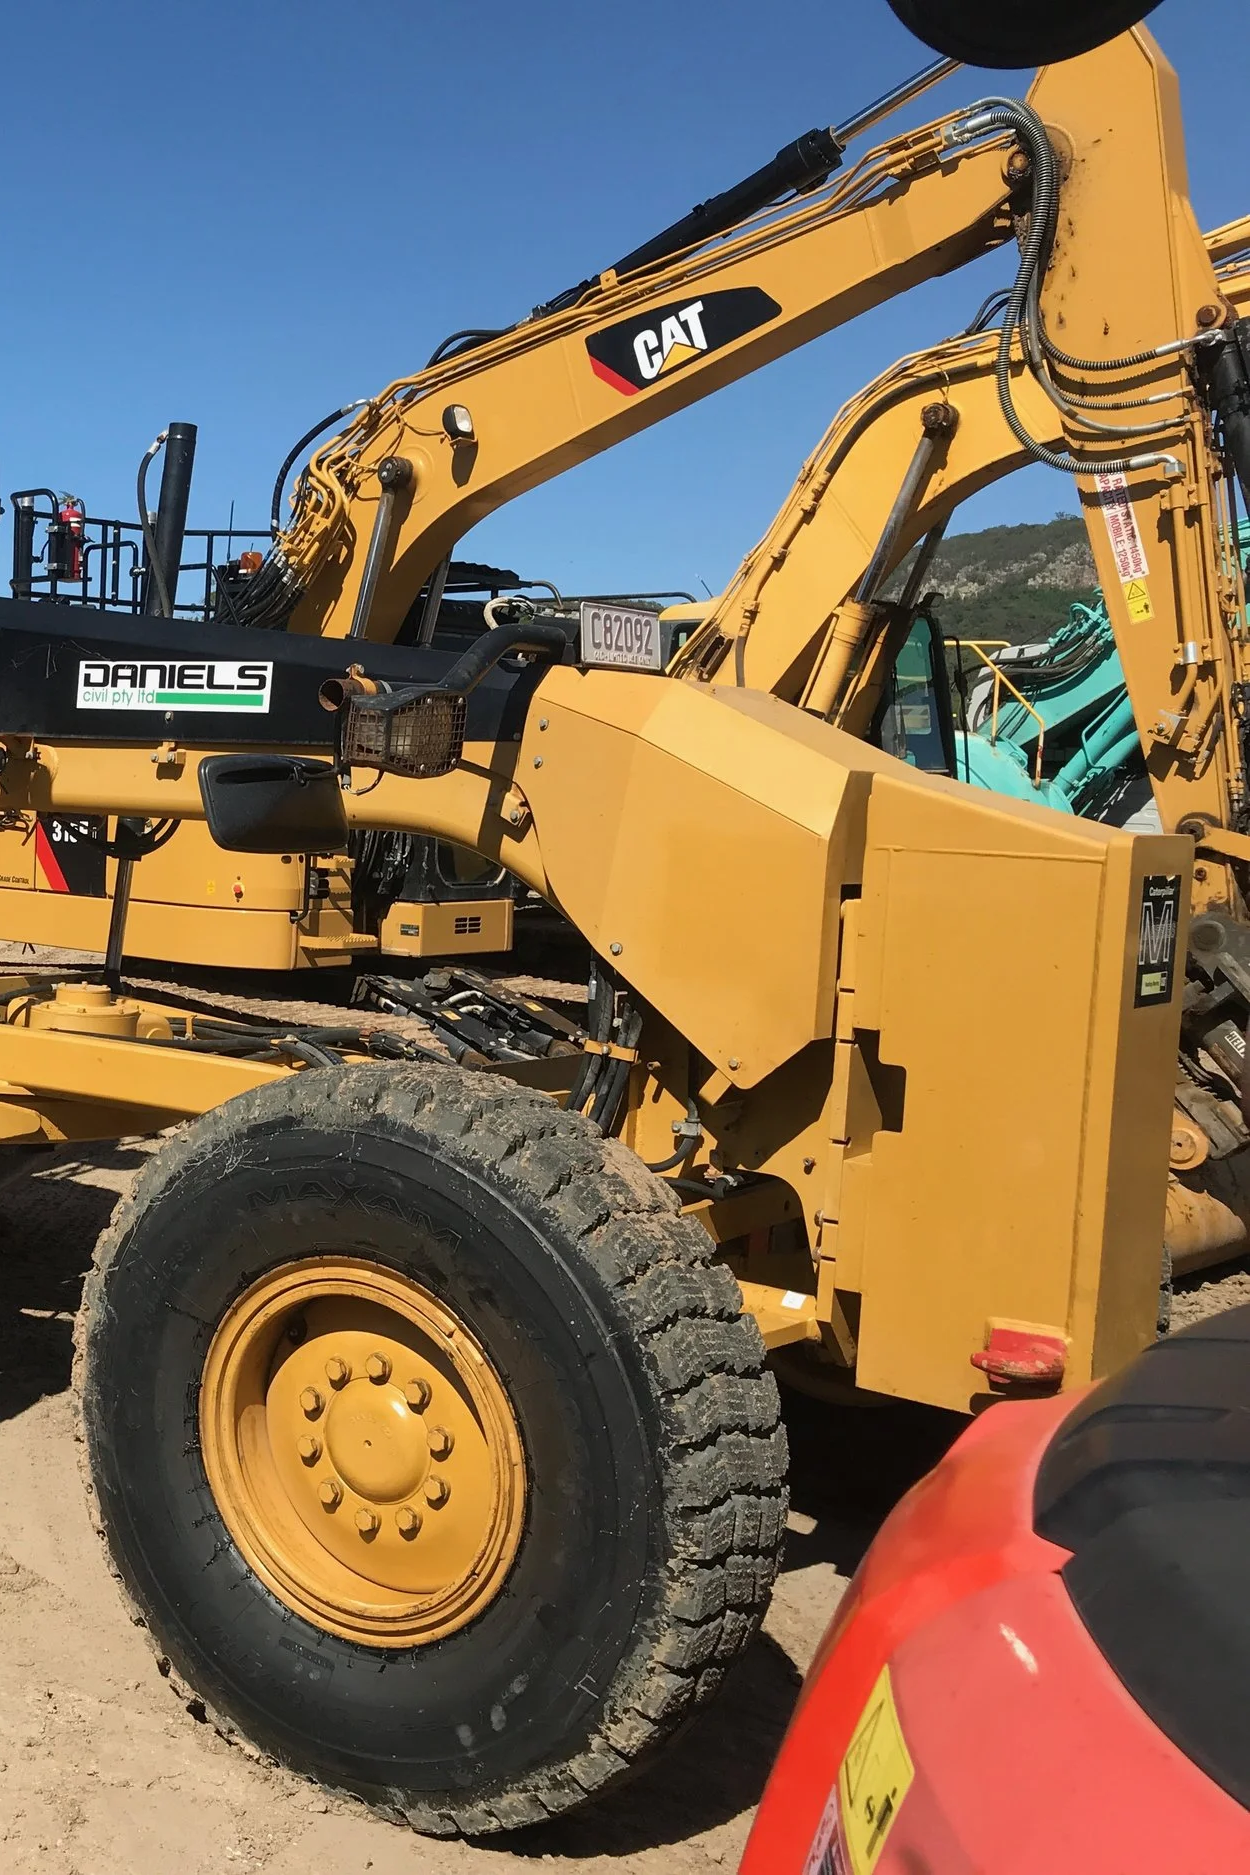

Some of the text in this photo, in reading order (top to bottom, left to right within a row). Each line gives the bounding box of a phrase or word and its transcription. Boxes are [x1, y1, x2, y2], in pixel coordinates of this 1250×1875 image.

[633, 300, 708, 379] CAT
[1098, 473, 1116, 511] APACITY
[1112, 478, 1129, 509] RATED
[591, 611, 653, 656] C82092
[83, 664, 269, 690] DANIELS
[83, 689, 155, 706] civil pty ltd
[246, 1176, 462, 1253] MAXAM
